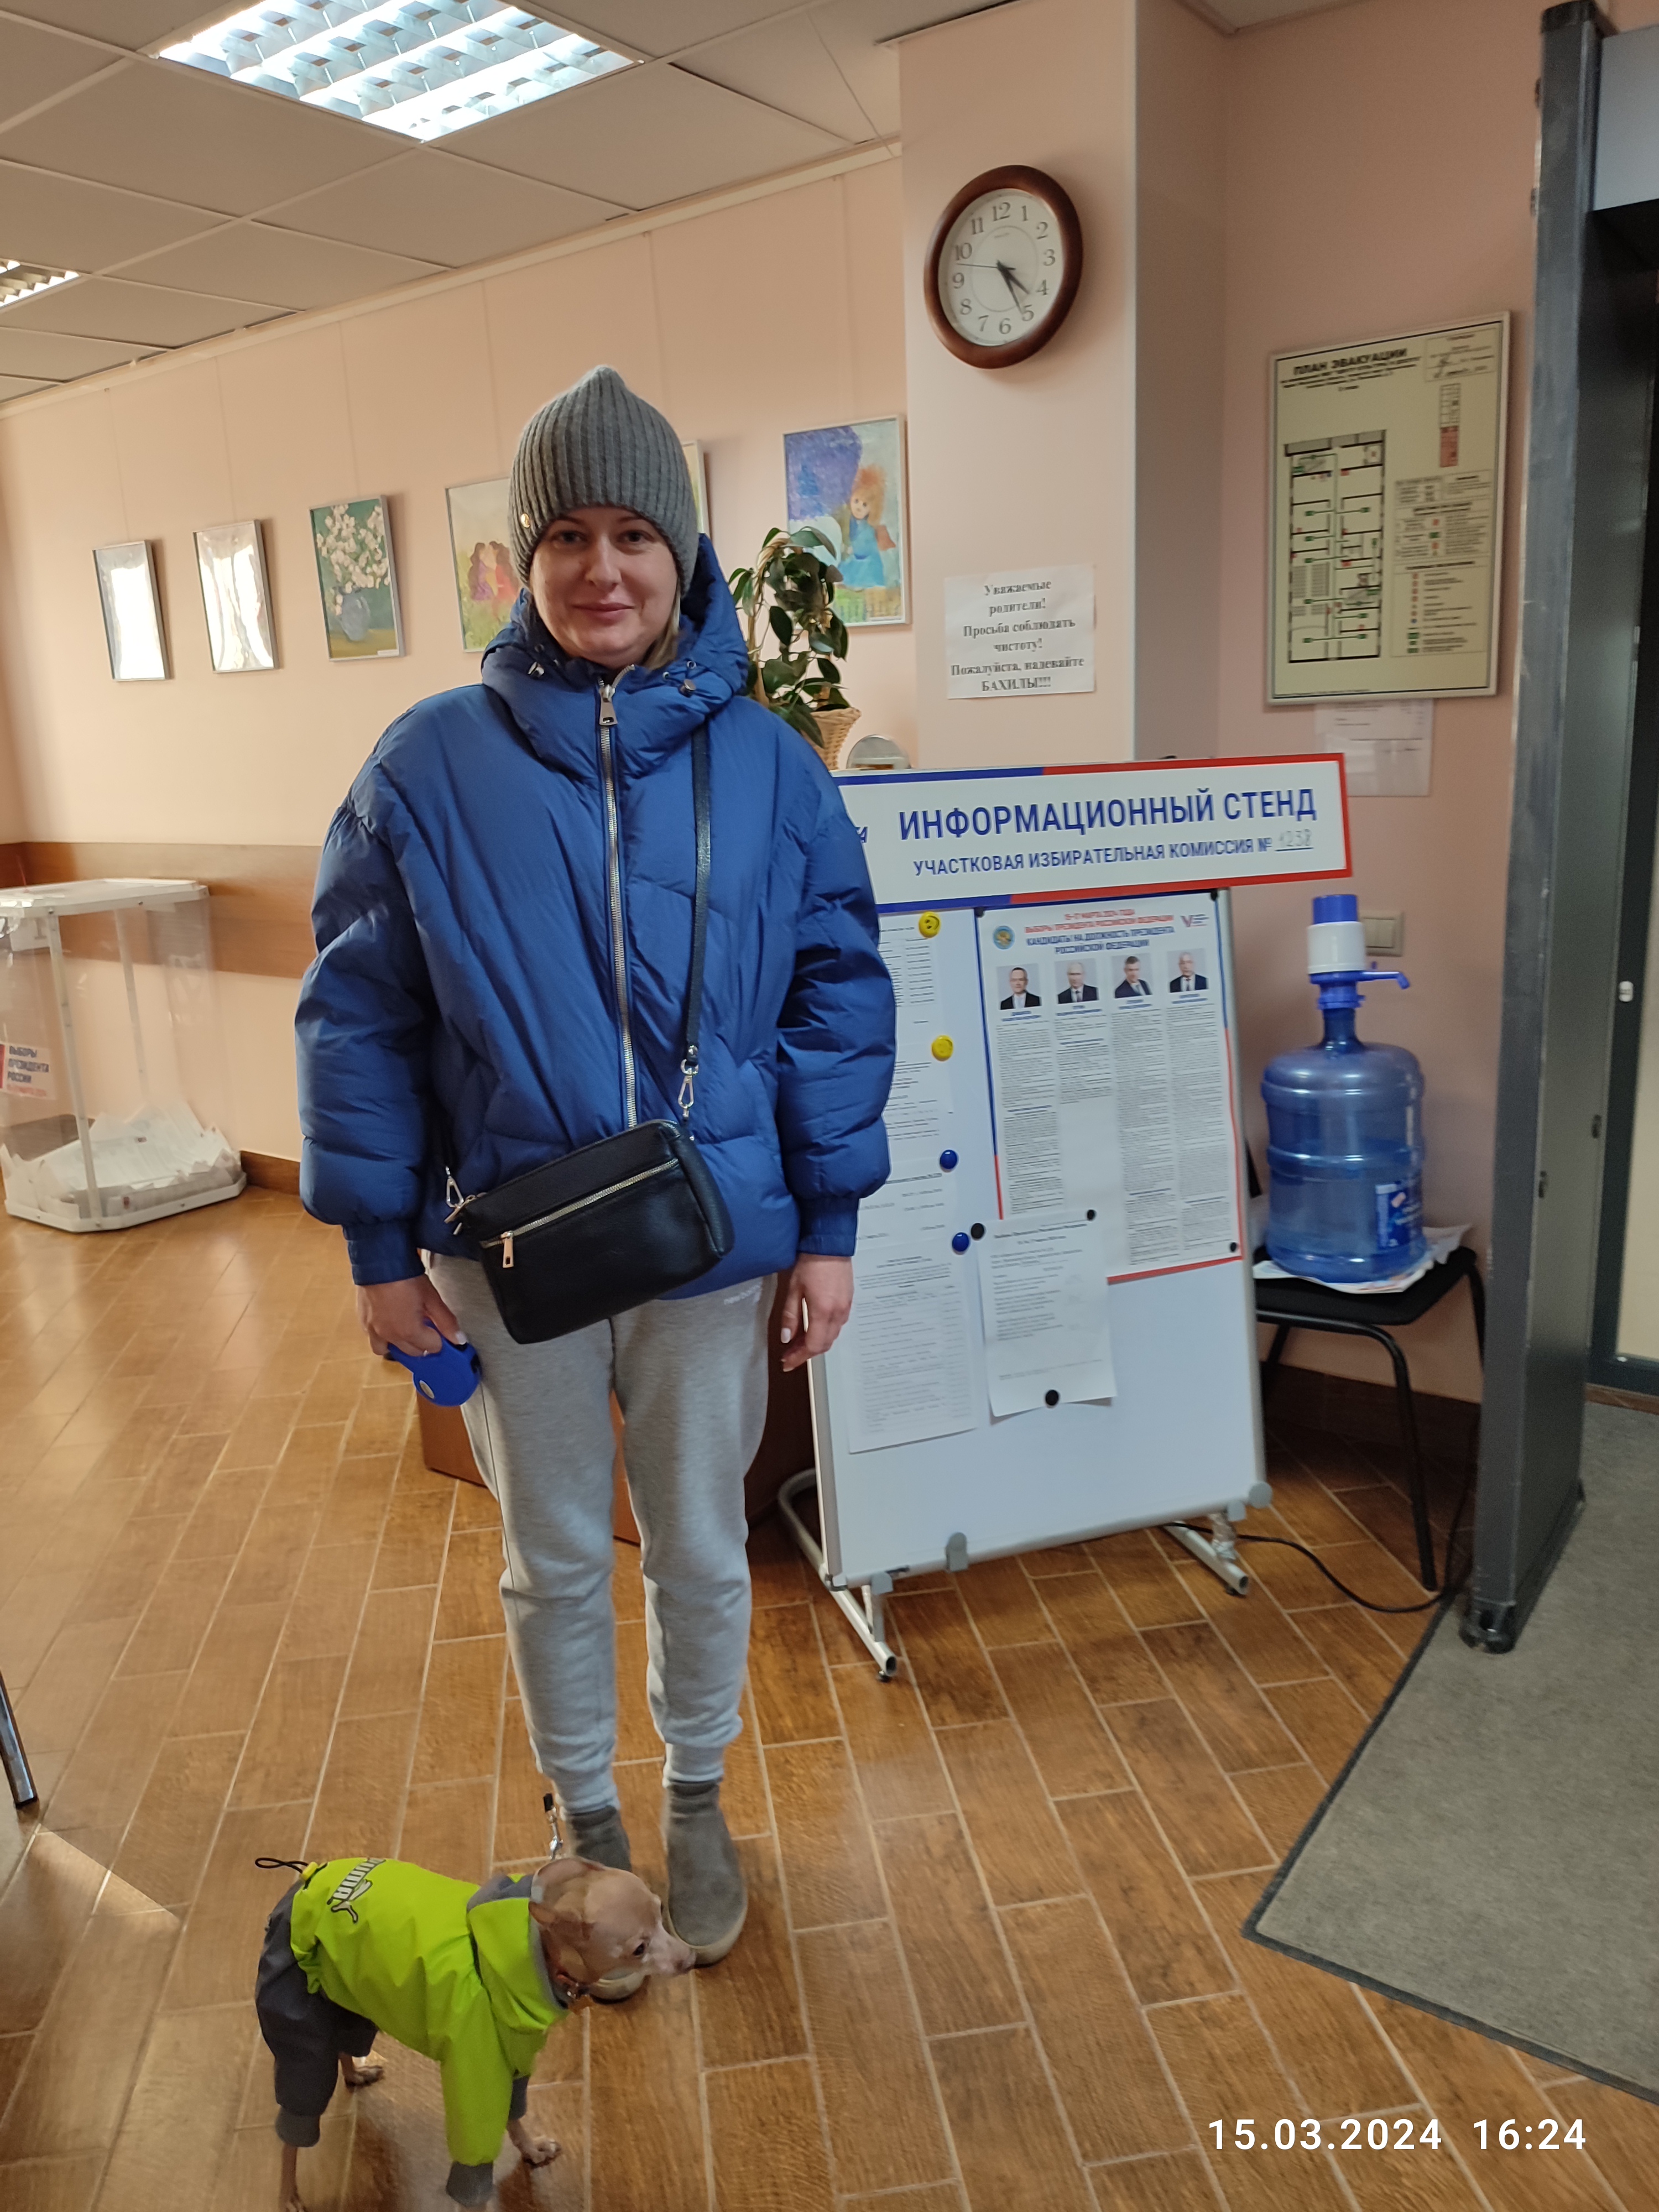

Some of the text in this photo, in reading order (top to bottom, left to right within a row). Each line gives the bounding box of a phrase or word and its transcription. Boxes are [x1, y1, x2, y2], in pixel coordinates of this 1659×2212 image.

[993, 202, 1010, 221] 12
[1022, 205, 1029, 221] 1
[972, 217, 984, 235] 11
[1036, 222, 1048, 239] 2
[954, 242, 972, 260] 10
[1043, 249, 1056, 266] 3
[952, 272, 964, 289] 9
[1036, 279, 1049, 295] 4
[960, 299, 972, 315] 8
[1022, 305, 1034, 321] 5
[978, 315, 989, 331] 7
[999, 317, 1011, 335] 6
[1293, 348, 1407, 376] ПЛАН ЭВАКУАЦИИ
[984, 581, 1052, 596] Уважаемые
[989, 598, 1046, 617] родители!
[963, 619, 1076, 639] Просьба соблюдать
[994, 638, 1043, 653] чистоту!
[951, 656, 1084, 676] Пожалуйста, надевайте
[899, 787, 1317, 840] ИНФОРМАЦИОННЫЙ СТЕНД
[914, 853, 1024, 877] УЧАСТКОВАЯ
[1029, 844, 1165, 868] ИЗБИРАТЕЛЬНАЯ
[1169, 838, 1253, 859] КОМИССИЯ
